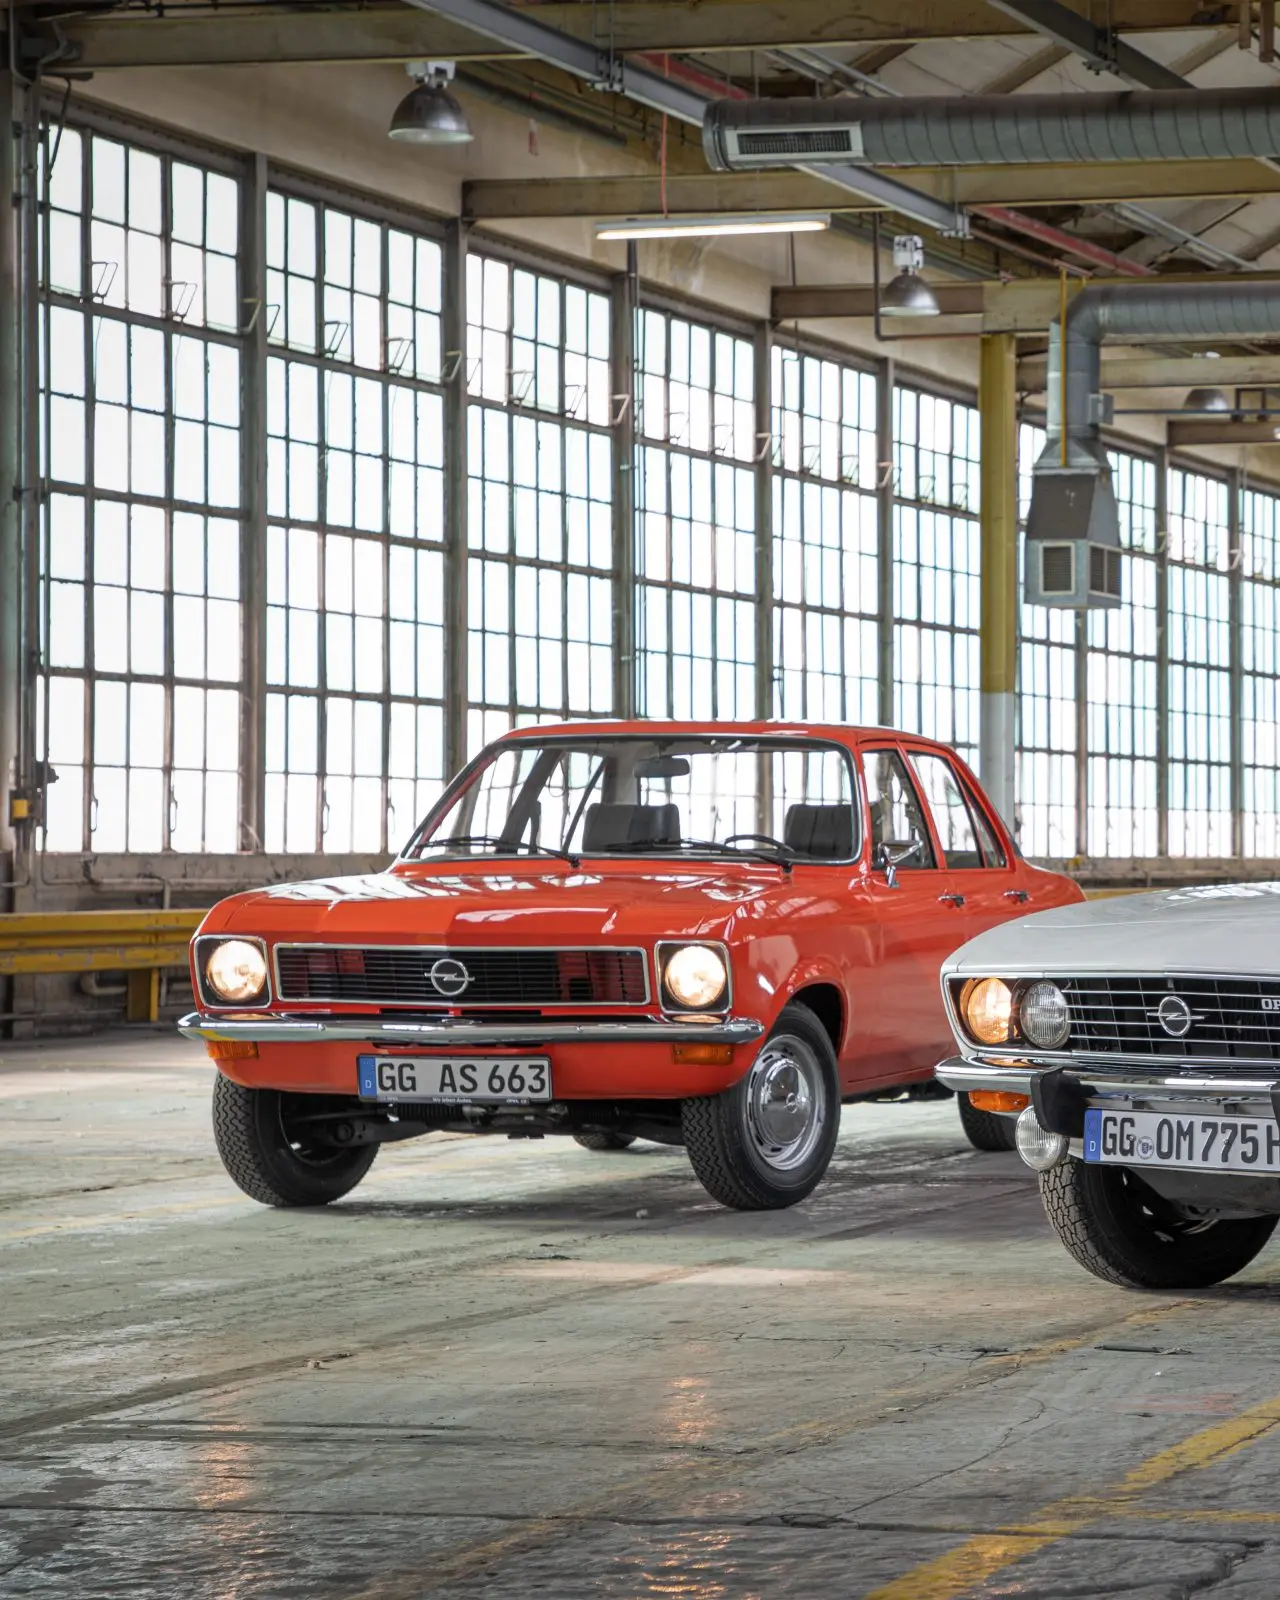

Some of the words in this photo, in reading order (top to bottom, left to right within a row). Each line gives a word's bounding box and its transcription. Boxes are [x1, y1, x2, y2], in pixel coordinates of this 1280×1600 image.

[365, 1079, 372, 1088] D
[377, 1063, 416, 1092] GG
[439, 1064, 478, 1093] AS
[488, 1064, 546, 1094] 663
[1089, 1140, 1096, 1152] D
[1102, 1116, 1136, 1157] GG
